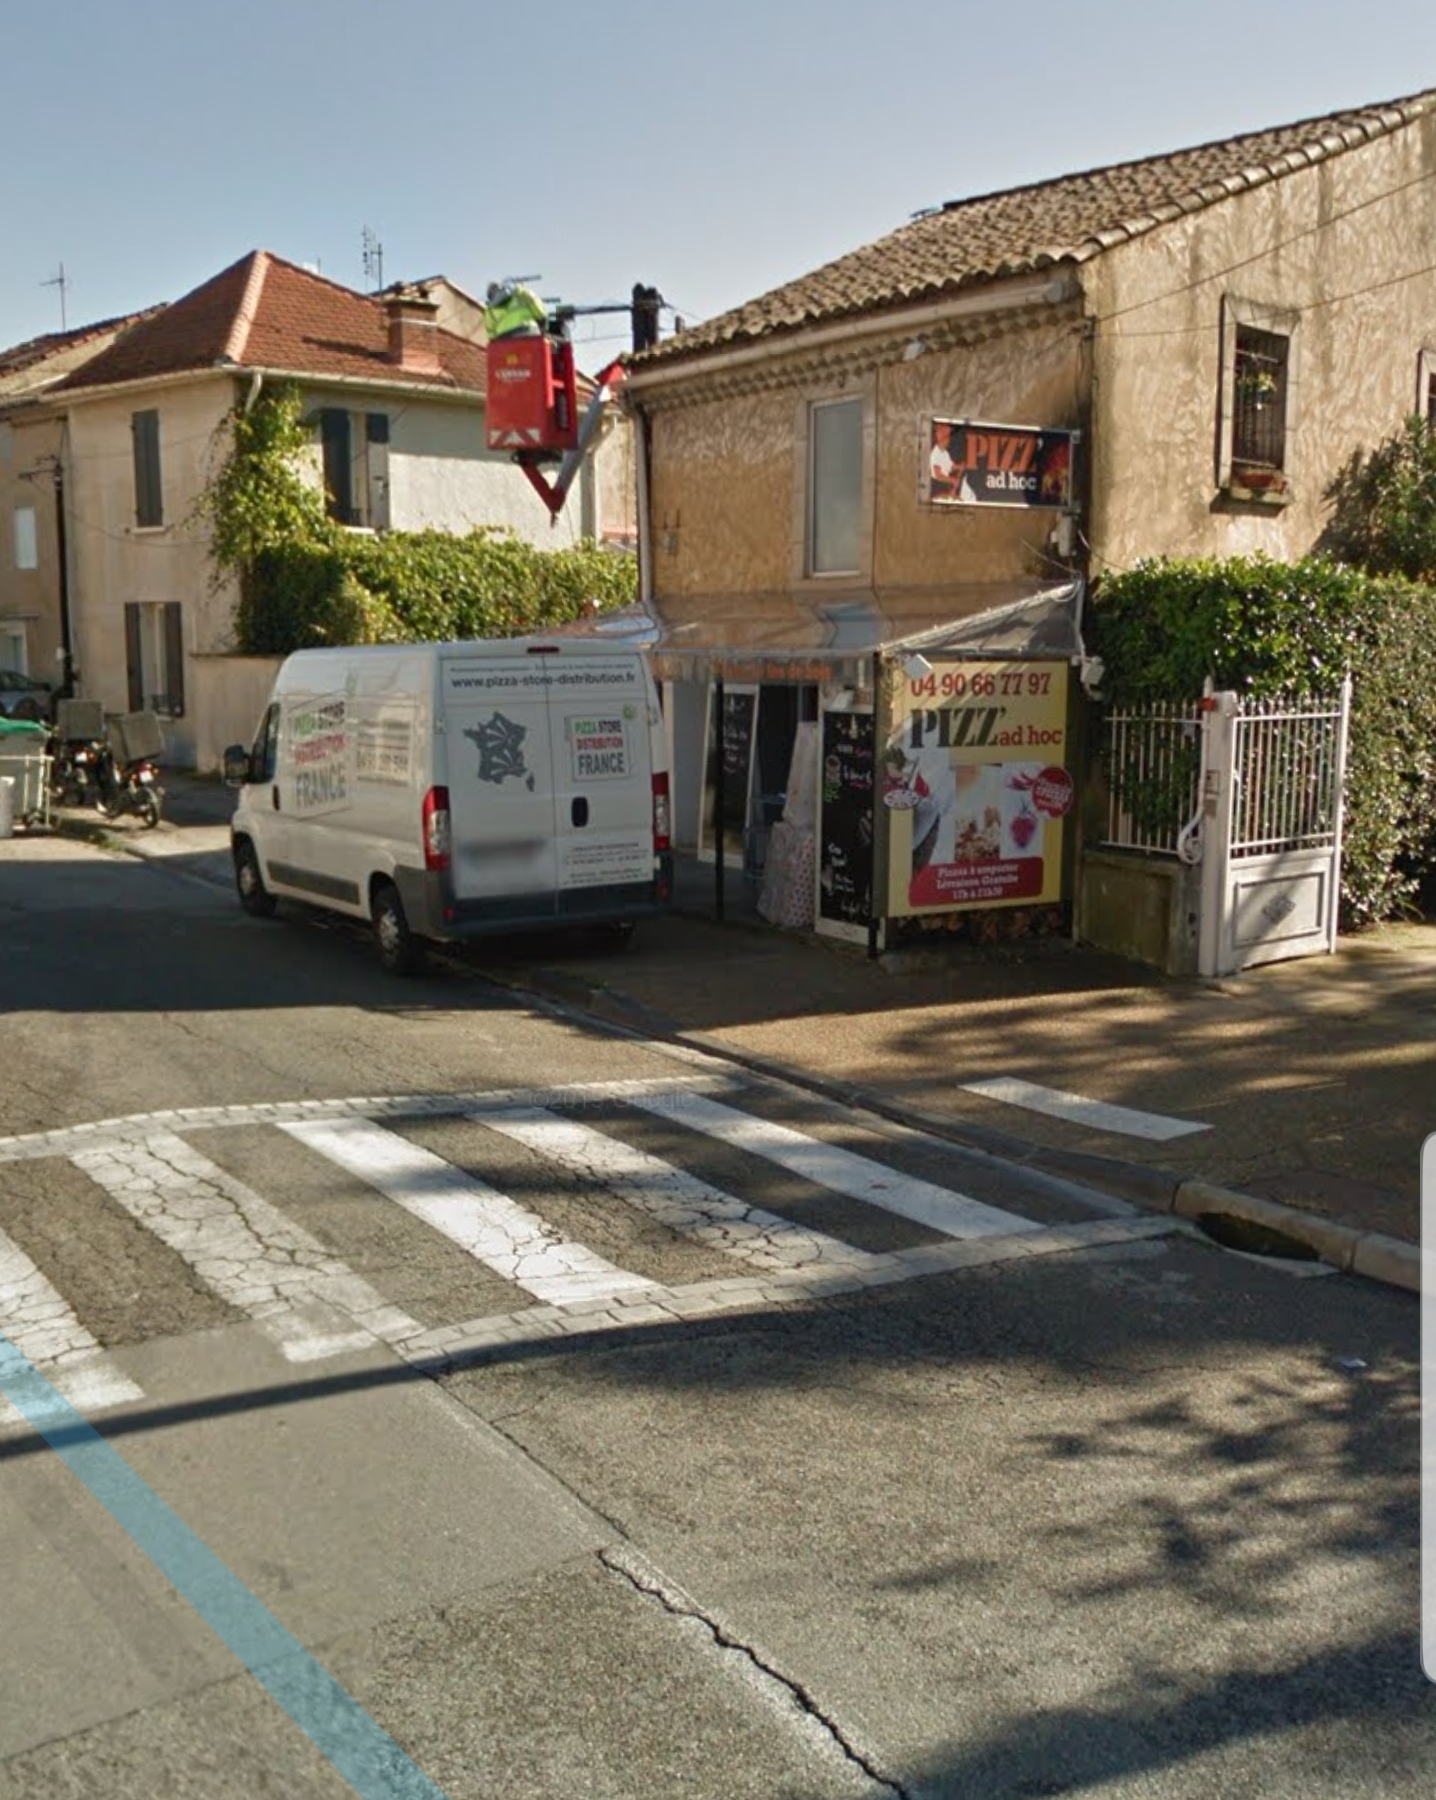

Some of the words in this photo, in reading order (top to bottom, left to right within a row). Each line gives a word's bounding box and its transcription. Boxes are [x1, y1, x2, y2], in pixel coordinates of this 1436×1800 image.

[966, 432, 1044, 473] PIZZ'
[985, 472, 1006, 489] ad
[1008, 472, 1036, 490] hoc
[451, 672, 635, 689] www.pizza-store-distribution.fr
[911, 673, 937, 698] 04
[941, 673, 966, 697] 90
[971, 673, 995, 697] 66
[1001, 673, 1023, 696] 77
[1028, 672, 1052, 696] 97
[574, 720, 598, 734] PIZZA
[599, 719, 622, 733] STORE
[909, 706, 1007, 749] PIZZ'
[1000, 726, 1023, 746] ad
[1028, 724, 1062, 746] hoc
[576, 736, 623, 750] DISTRIBUTION
[578, 752, 625, 776] FRANCE
[296, 762, 346, 808] FRANCE
